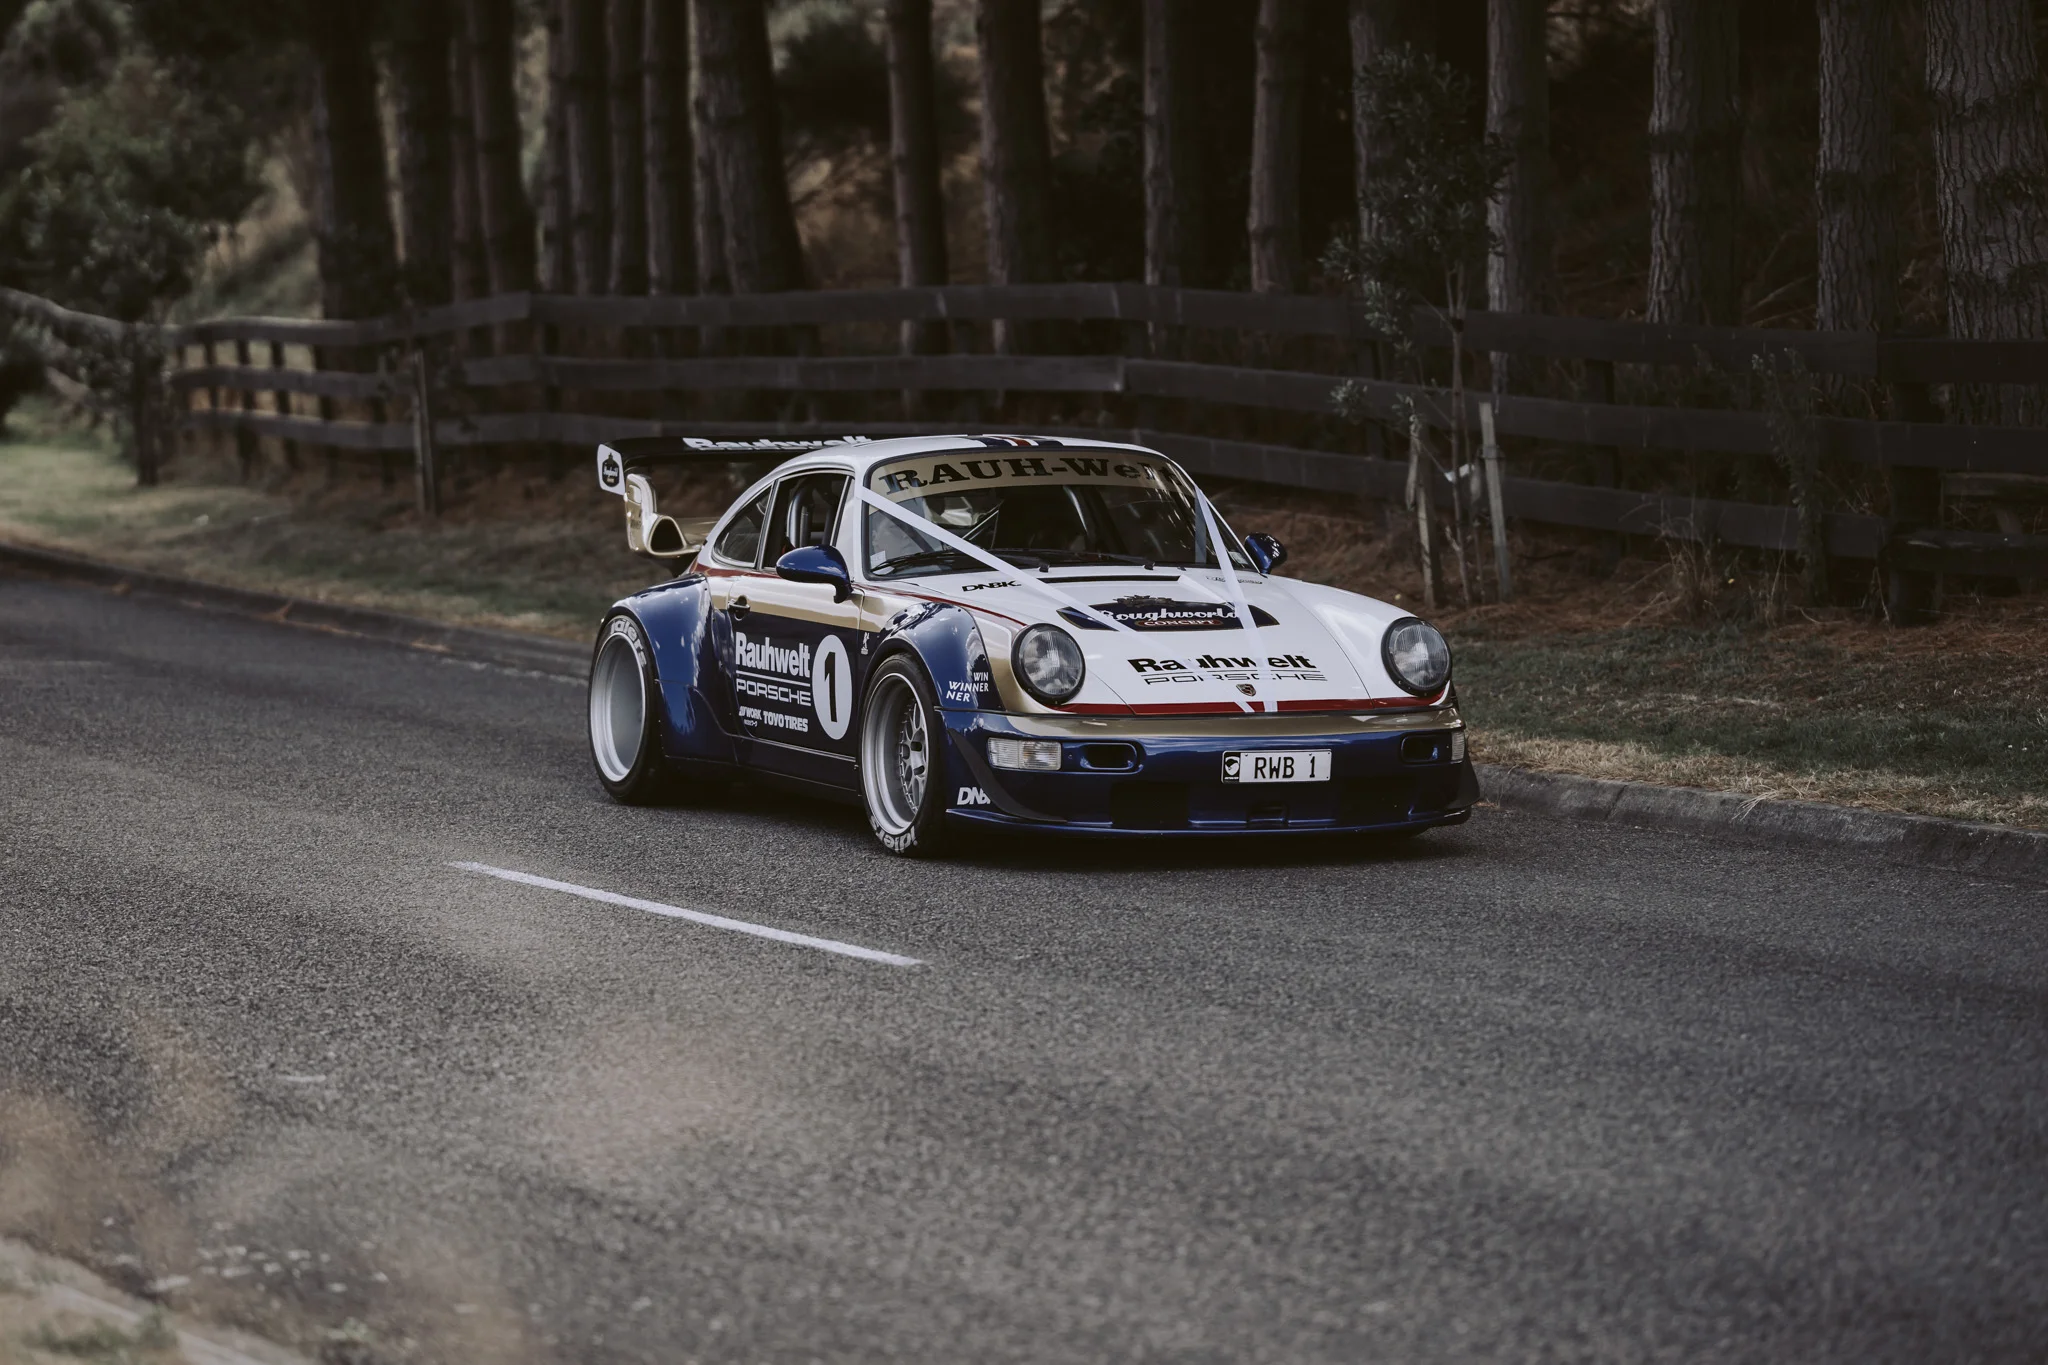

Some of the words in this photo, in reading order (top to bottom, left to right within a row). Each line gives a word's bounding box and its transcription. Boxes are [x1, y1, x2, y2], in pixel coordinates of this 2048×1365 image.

[735, 631, 811, 678] Rauhwelt
[824, 651, 838, 723] 1
[973, 671, 989, 681] WIN
[736, 678, 812, 706] PORSCHE
[763, 710, 785, 728] TOYO
[784, 714, 809, 733] TIRES
[1254, 756, 1295, 779] RWB
[1309, 755, 1316, 778] 1
[957, 786, 991, 805] DNB
